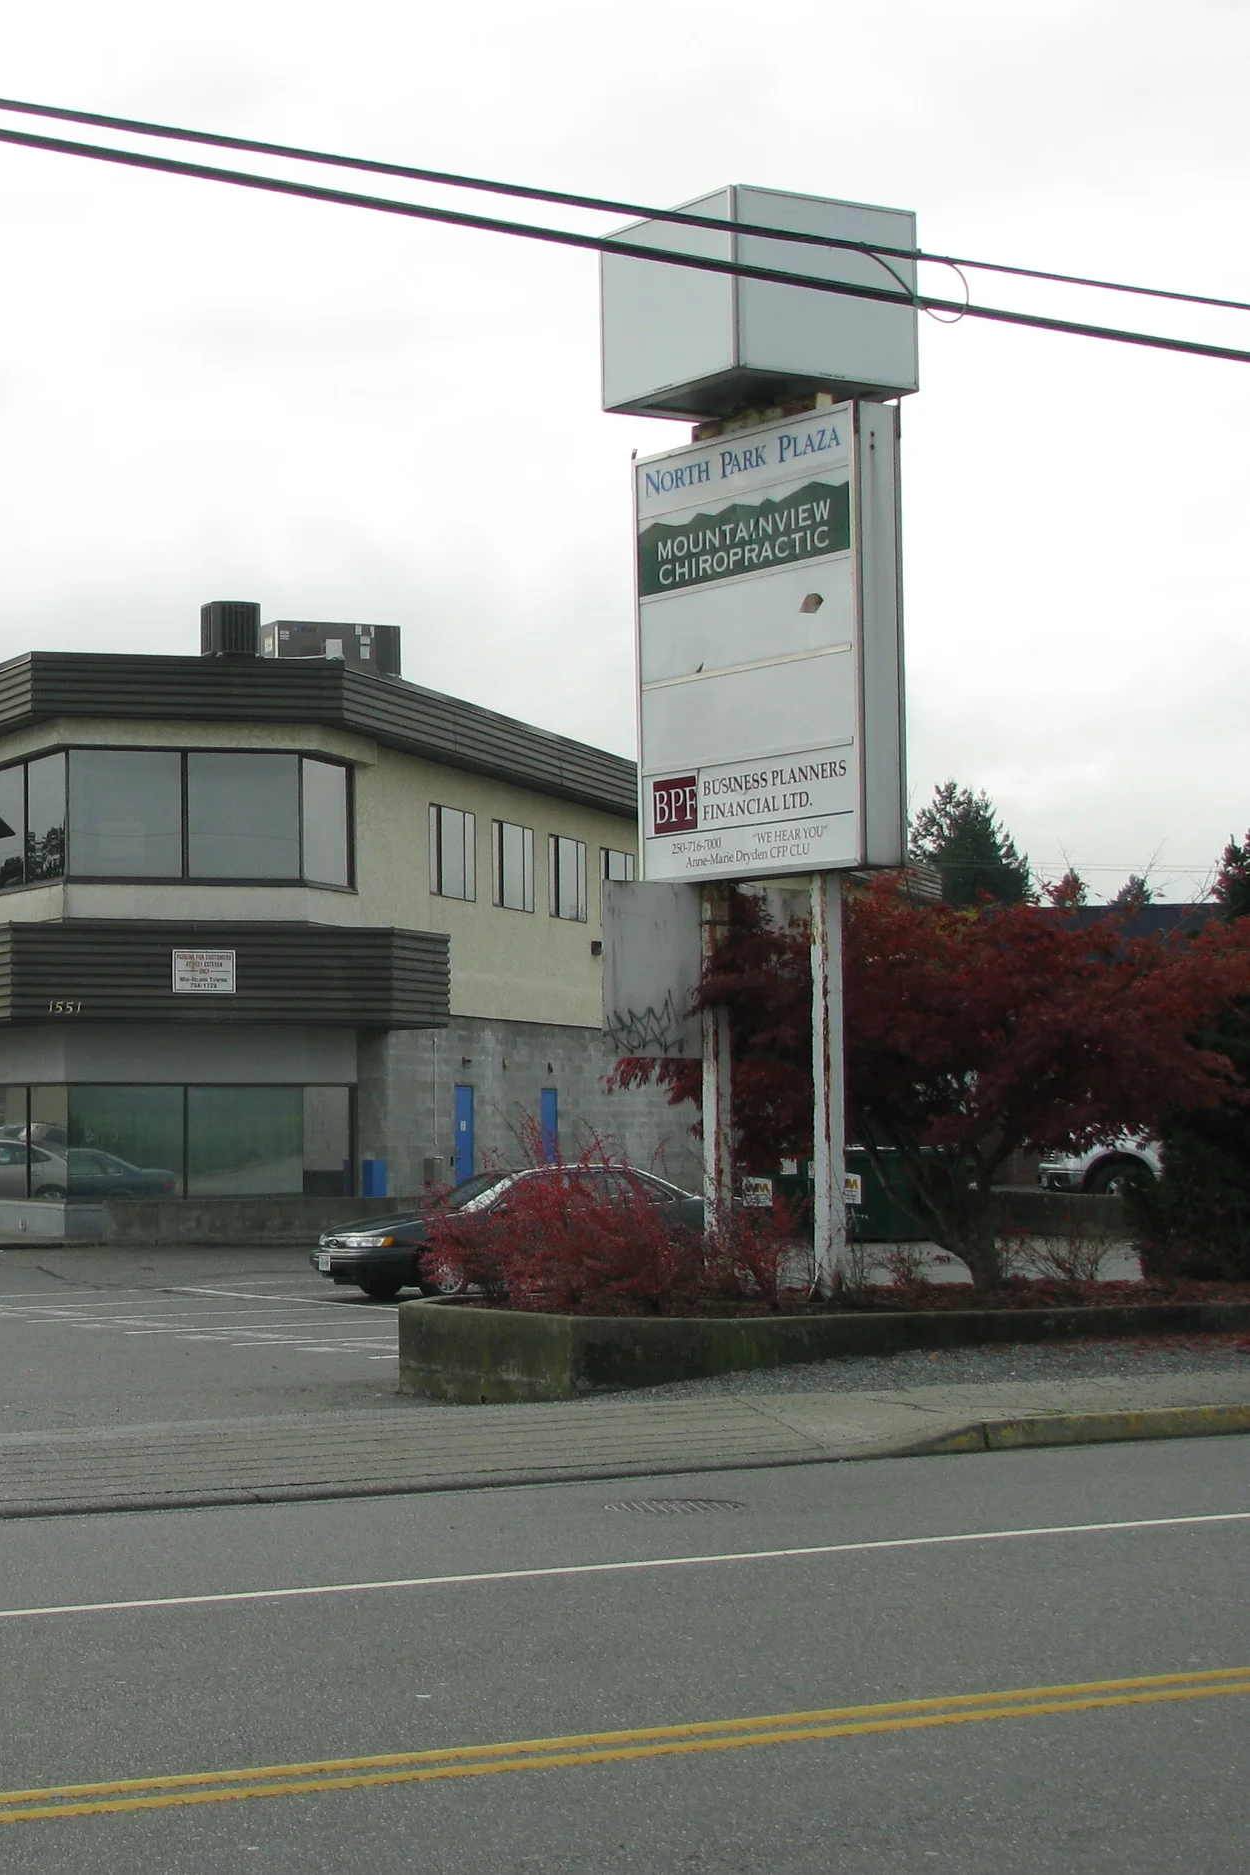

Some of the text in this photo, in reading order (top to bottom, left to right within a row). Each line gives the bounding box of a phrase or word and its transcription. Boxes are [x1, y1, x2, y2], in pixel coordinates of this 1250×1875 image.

[645, 426, 841, 498] NORTH PARK PLAZA
[657, 498, 831, 562] MOUNTAINVIEW
[658, 526, 830, 586] CHIROPRACTIC
[703, 759, 847, 797] BUSINESS PLANNERS
[654, 785, 697, 824] BPF
[703, 791, 813, 821] FINANCIAL LTD.
[774, 829, 800, 842] HEAR
[686, 843, 810, 869] Anne-Marie Dryden CFP CLU
[49, 1001, 82, 1014] 1551
